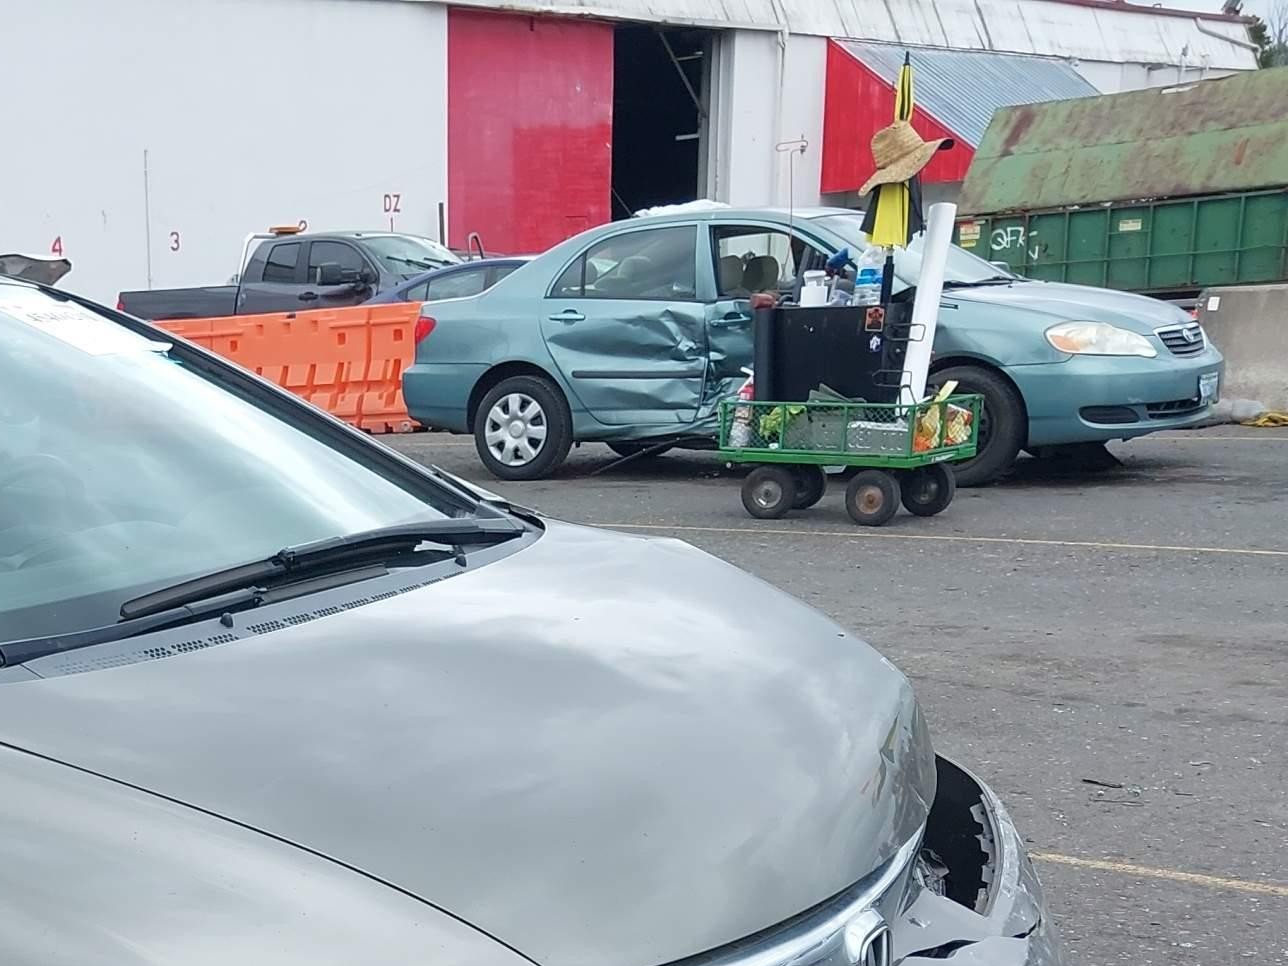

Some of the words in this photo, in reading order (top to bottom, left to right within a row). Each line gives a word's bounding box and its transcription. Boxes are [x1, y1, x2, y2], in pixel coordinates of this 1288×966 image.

[383, 194, 400, 212] DZ
[51, 235, 63, 256] 4
[170, 232, 180, 251] 3
